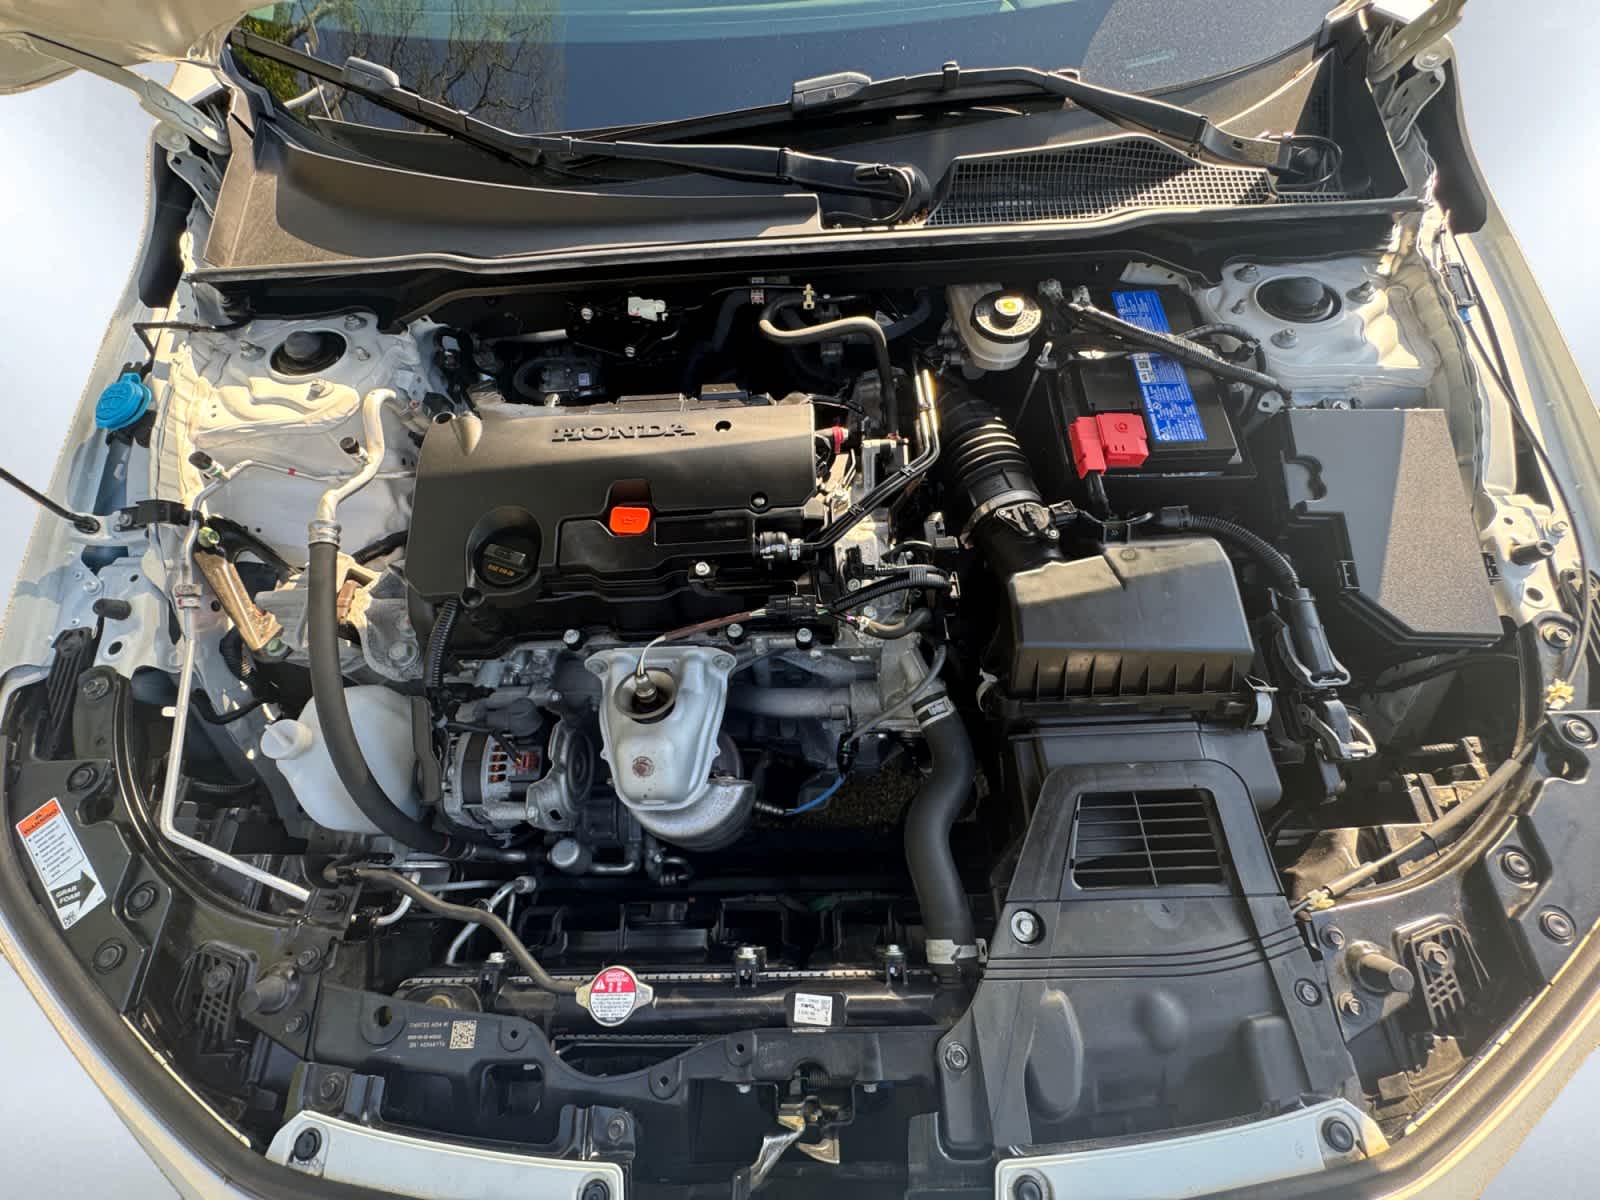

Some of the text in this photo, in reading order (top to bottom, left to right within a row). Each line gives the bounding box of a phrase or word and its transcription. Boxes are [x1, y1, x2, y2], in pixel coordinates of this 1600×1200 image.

[551, 423, 696, 442] HONDA
[55, 885, 78, 899] GRAB
[59, 891, 81, 904] FOAM
